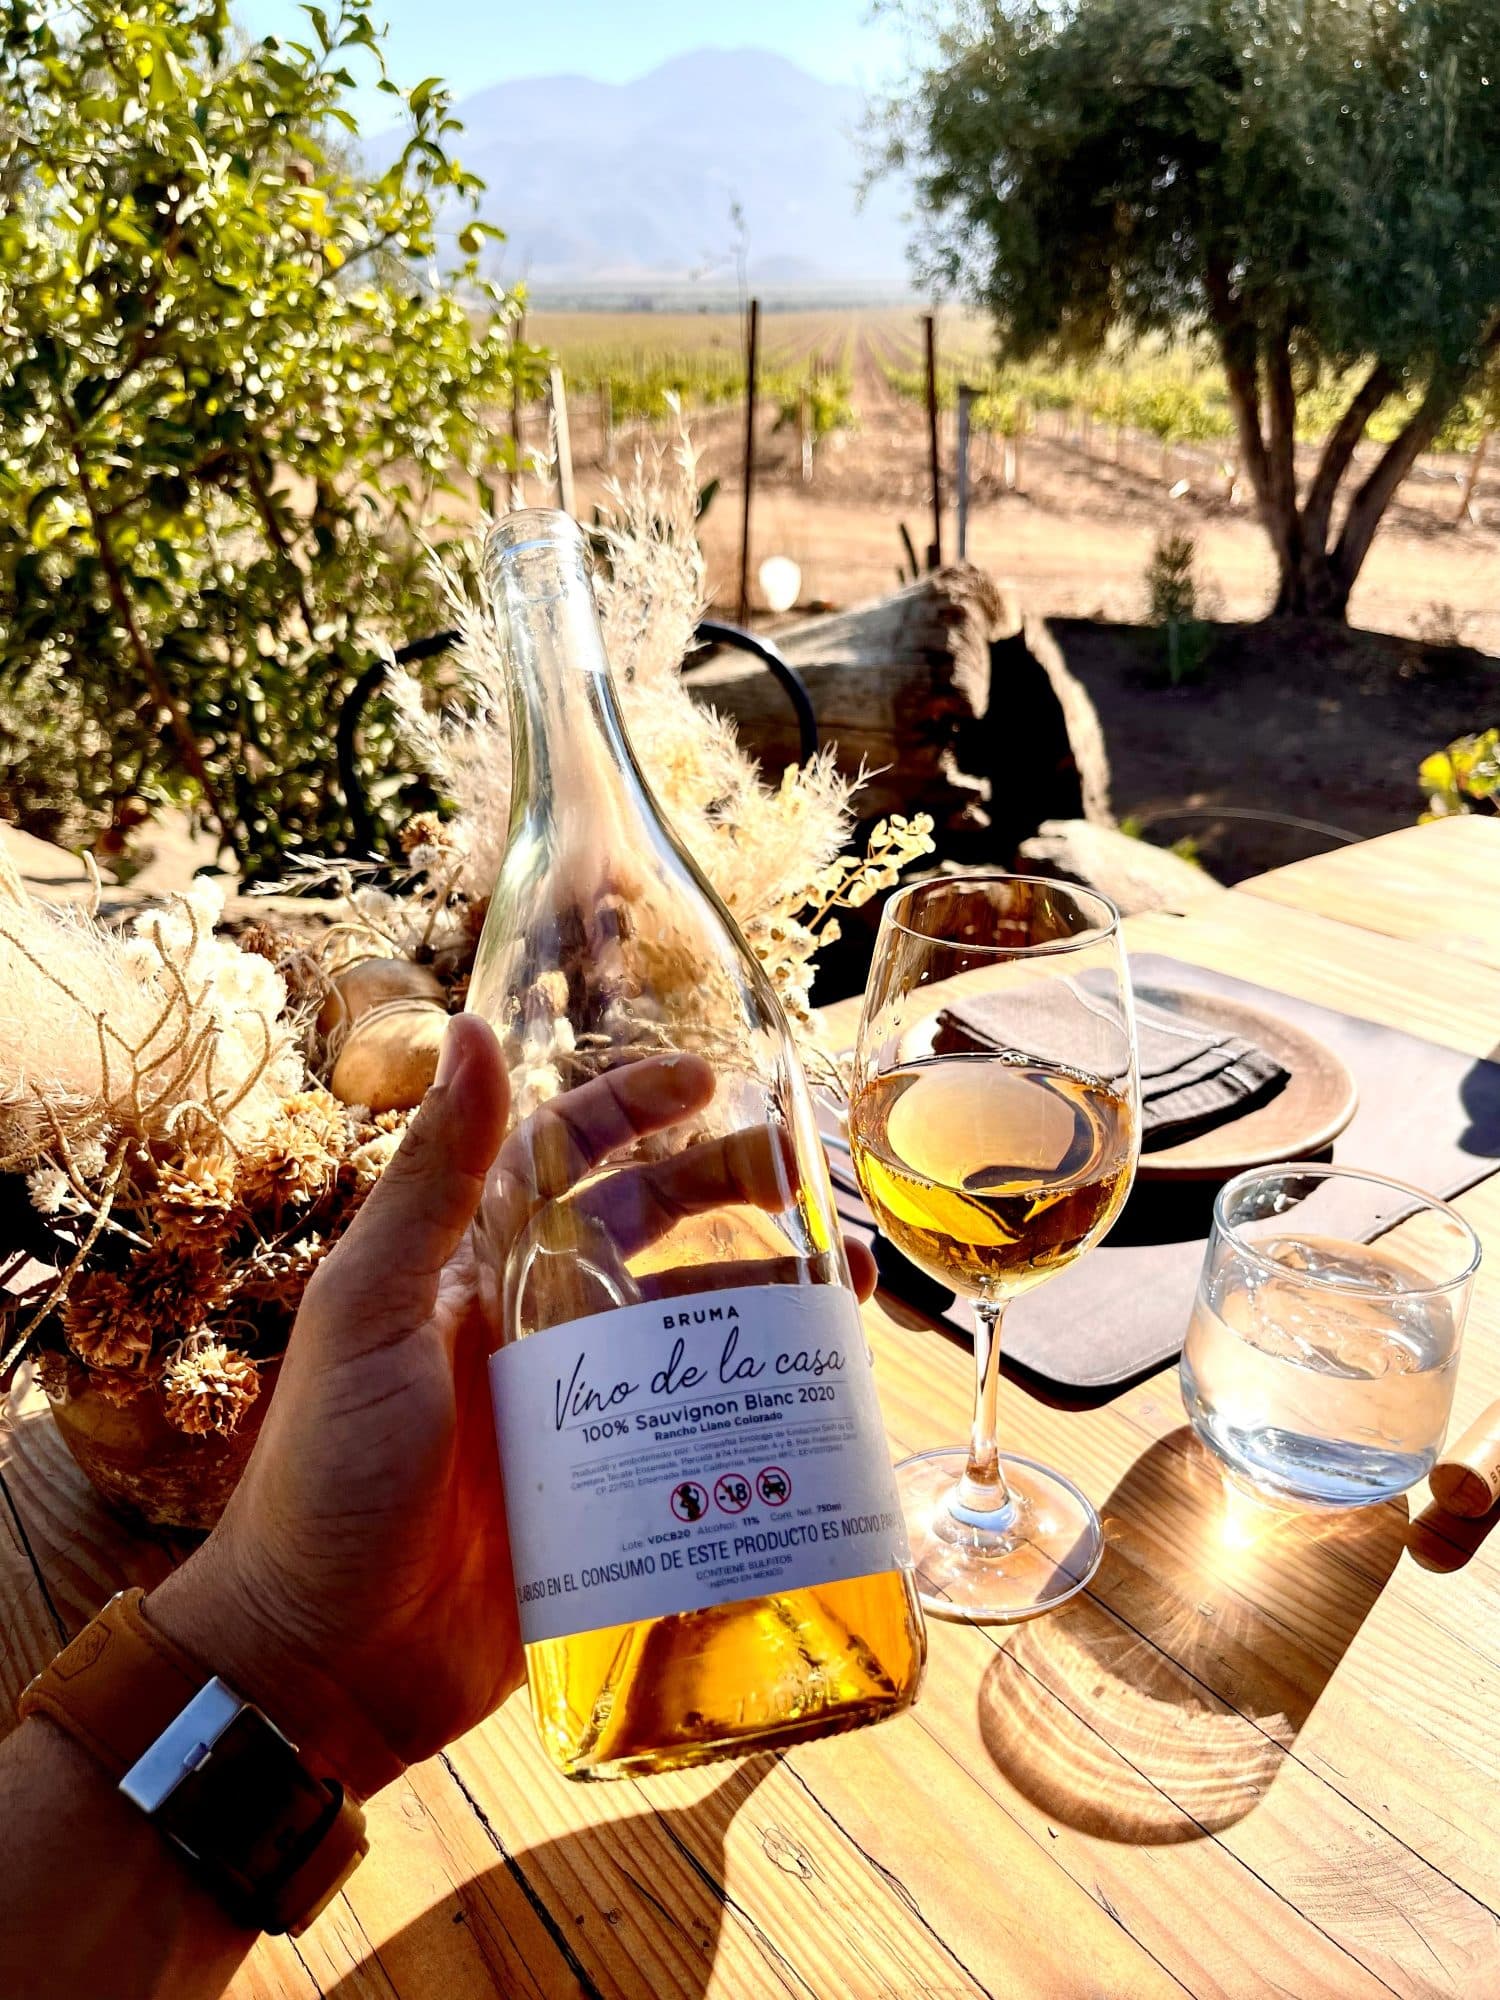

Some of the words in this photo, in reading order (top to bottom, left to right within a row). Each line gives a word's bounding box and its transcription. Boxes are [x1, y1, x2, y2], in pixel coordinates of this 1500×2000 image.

[664, 1305, 740, 1330] BRUMA
[556, 1352, 639, 1431] Vino
[651, 1337, 707, 1395] de
[719, 1326, 767, 1384] la
[775, 1348, 846, 1376] casa
[582, 1419, 630, 1443] 100%
[635, 1399, 739, 1431] Sauvignon
[744, 1391, 794, 1411] Blanc
[798, 1386, 836, 1403] 2020
[655, 1425, 697, 1441] Rancho
[734, 1411, 783, 1426] Colorado
[647, 1528, 692, 1545] VDCB20
[742, 1516, 760, 1527] 11%
[523, 1579, 547, 1602] ABUSO
[547, 1577, 563, 1596] EN
[564, 1574, 579, 1593] EL
[581, 1555, 656, 1588] CONSUMO
[660, 1549, 684, 1571] DE
[687, 1540, 731, 1566] ESTE
[733, 1524, 819, 1557] PRODUCTO
[821, 1520, 840, 1541] ES
[841, 1513, 880, 1537] NOCIVO
